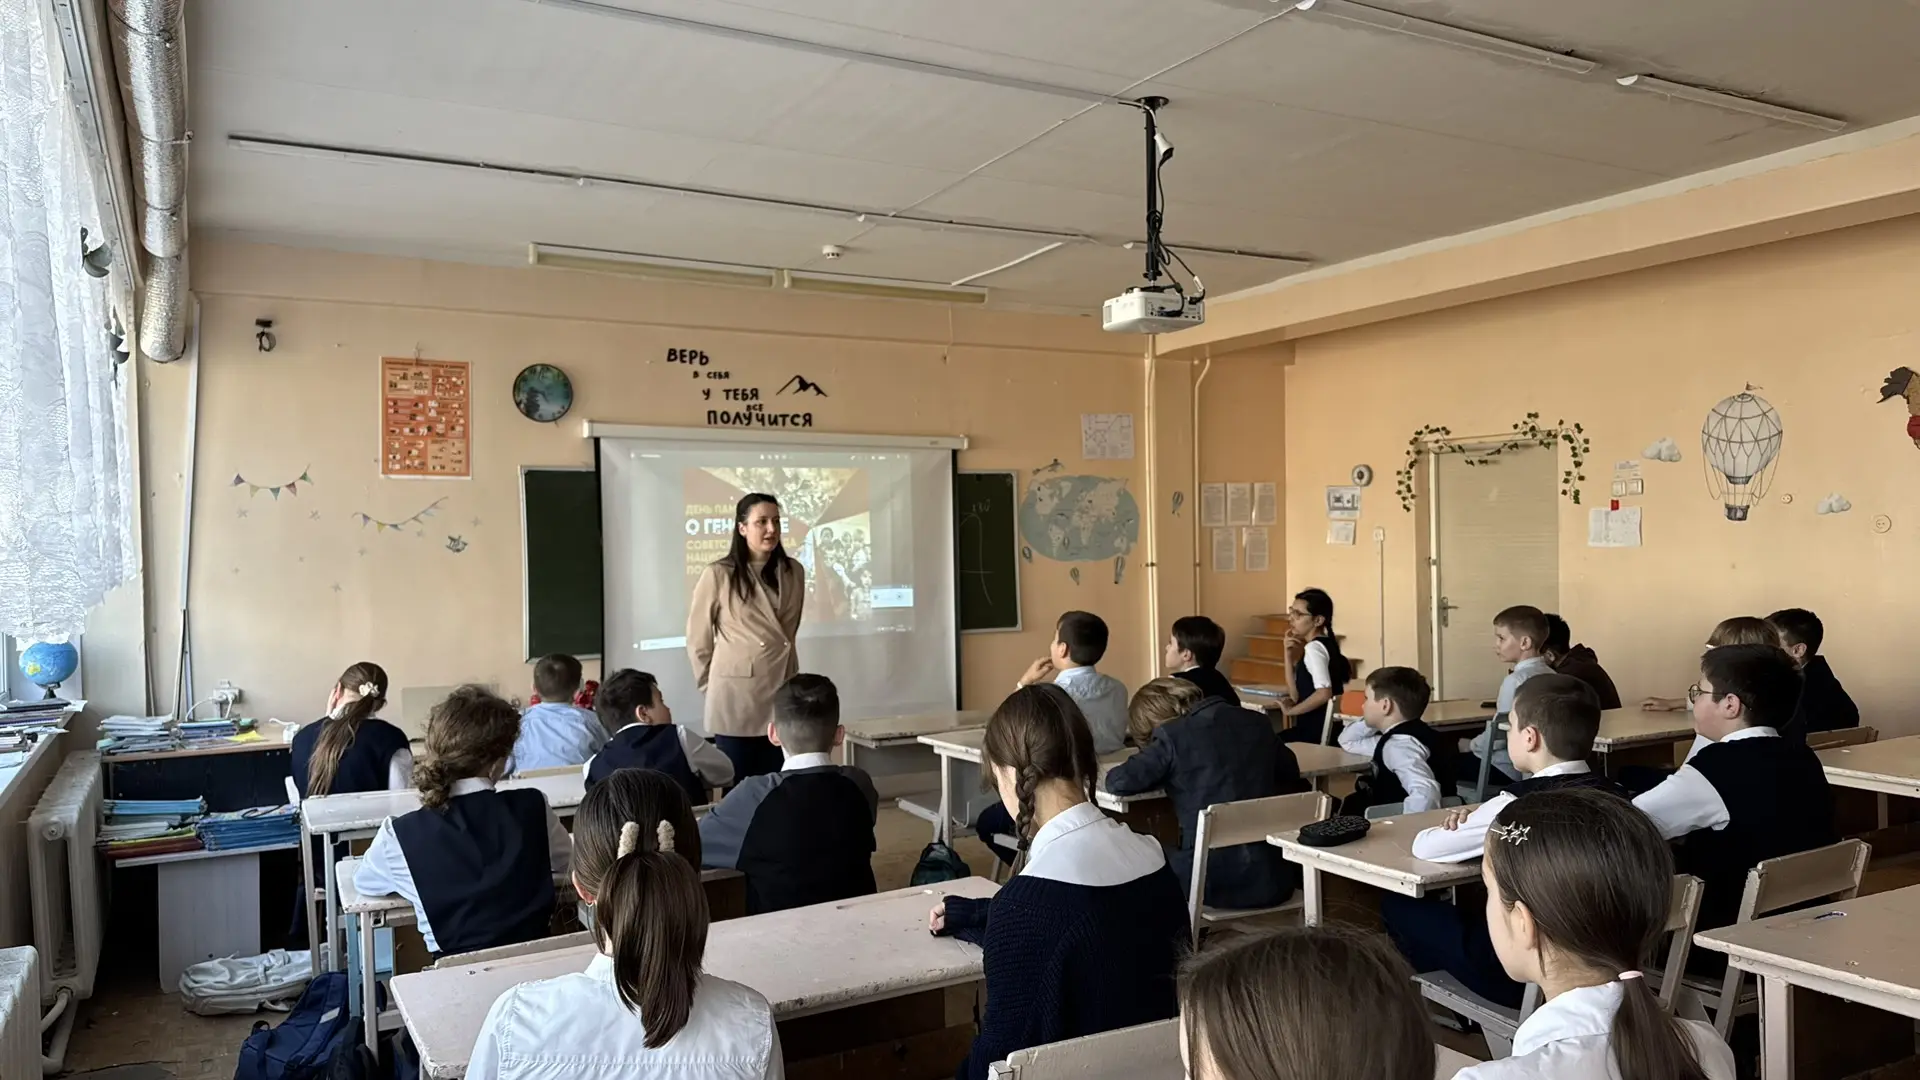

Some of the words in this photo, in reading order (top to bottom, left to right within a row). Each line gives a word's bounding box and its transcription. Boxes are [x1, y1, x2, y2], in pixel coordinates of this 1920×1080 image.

[666, 348, 710, 366] ВЕРЬ
[692, 371, 700, 379] В
[706, 371, 730, 379] СЕБЯ
[702, 388, 711, 400] У
[722, 388, 759, 401] ТЕБЯ
[746, 404, 764, 412] ВСЕ
[707, 410, 813, 427] ПОЛУЧИТСЯ
[685, 505, 712, 516] ДЕНЬ
[685, 518, 700, 535] О
